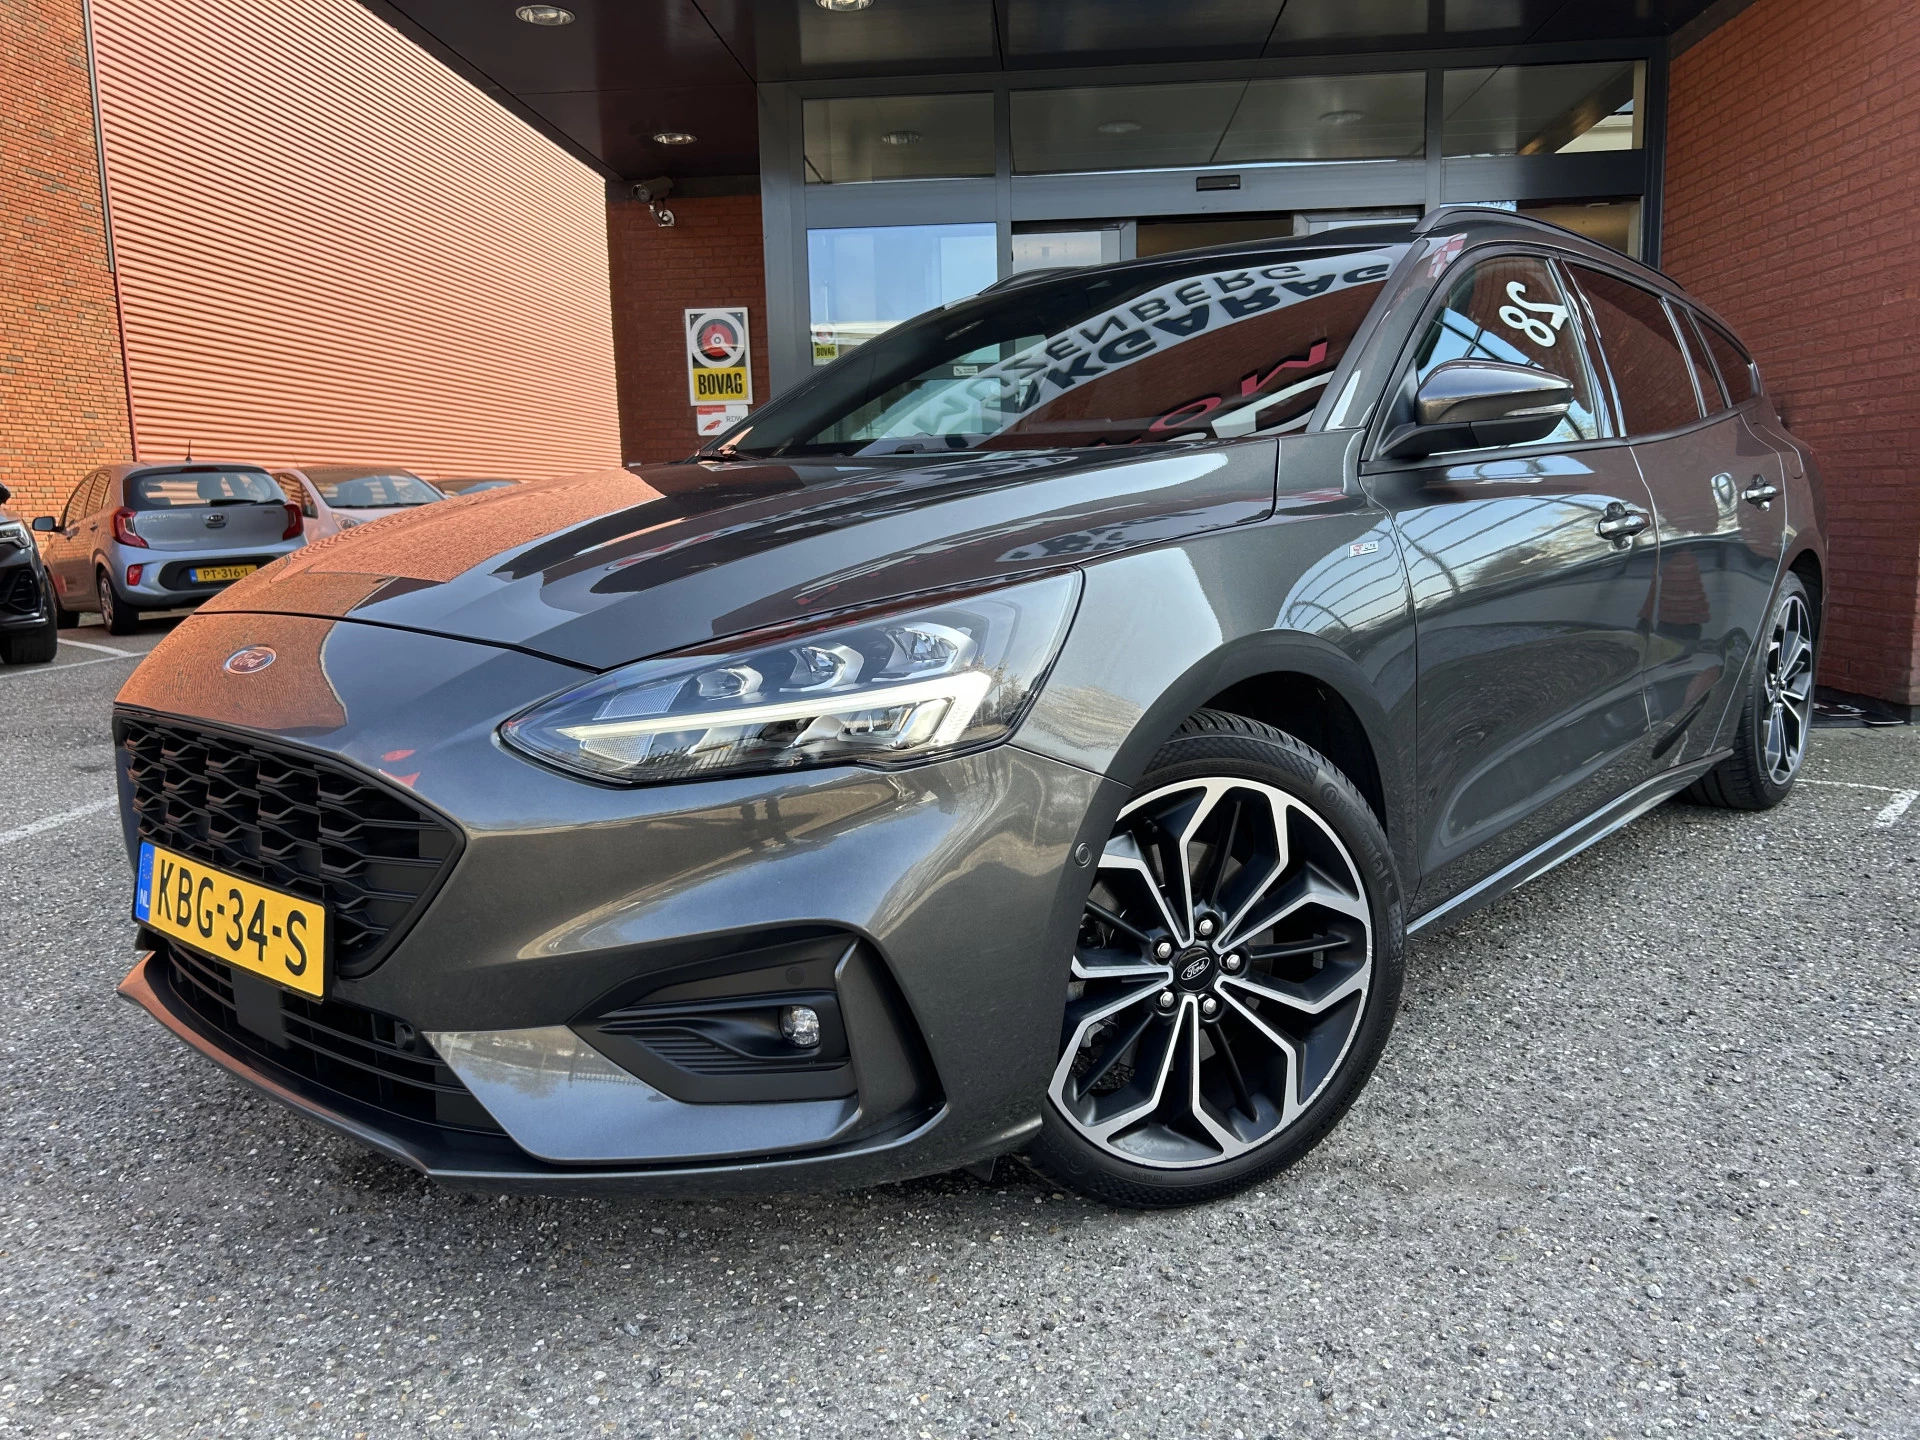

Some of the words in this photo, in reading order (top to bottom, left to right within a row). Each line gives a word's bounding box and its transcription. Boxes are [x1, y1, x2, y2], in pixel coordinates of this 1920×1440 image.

[816, 346, 836, 357] BOVAG
[697, 372, 743, 395] BOVAG
[139, 888, 150, 909] NL
[157, 858, 308, 977] KBG-34-S
[1186, 960, 1206, 978] Ford
